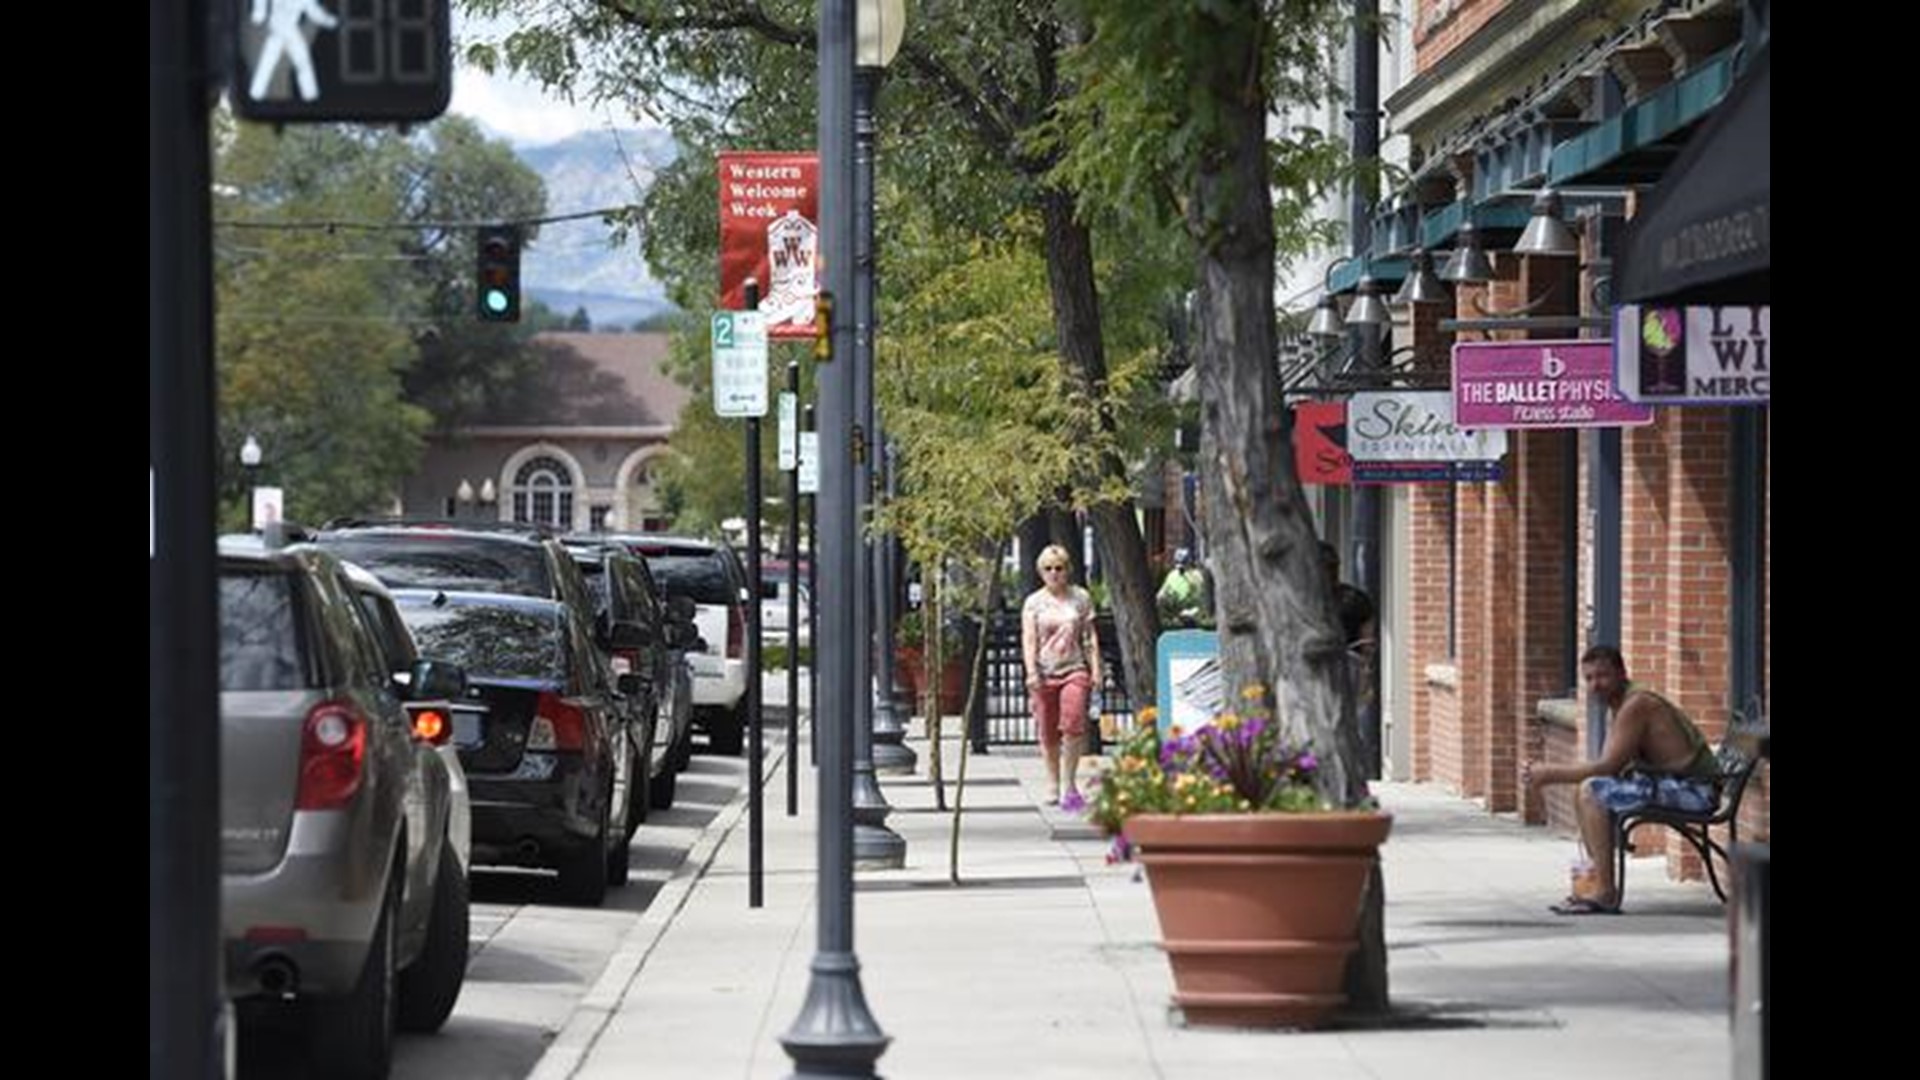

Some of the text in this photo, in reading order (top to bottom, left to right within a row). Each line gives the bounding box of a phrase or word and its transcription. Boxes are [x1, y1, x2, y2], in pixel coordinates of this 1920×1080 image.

[730, 164, 801, 179] Western
[730, 183, 807, 199] Welcome
[730, 203, 777, 218] Week
[716, 317, 732, 344] 2
[1709, 338, 1767, 372] WI
[1462, 379, 1622, 403] THE BALLET PHYSI
[1694, 376, 1769, 397] MERC
[1354, 399, 1457, 440] Skin
